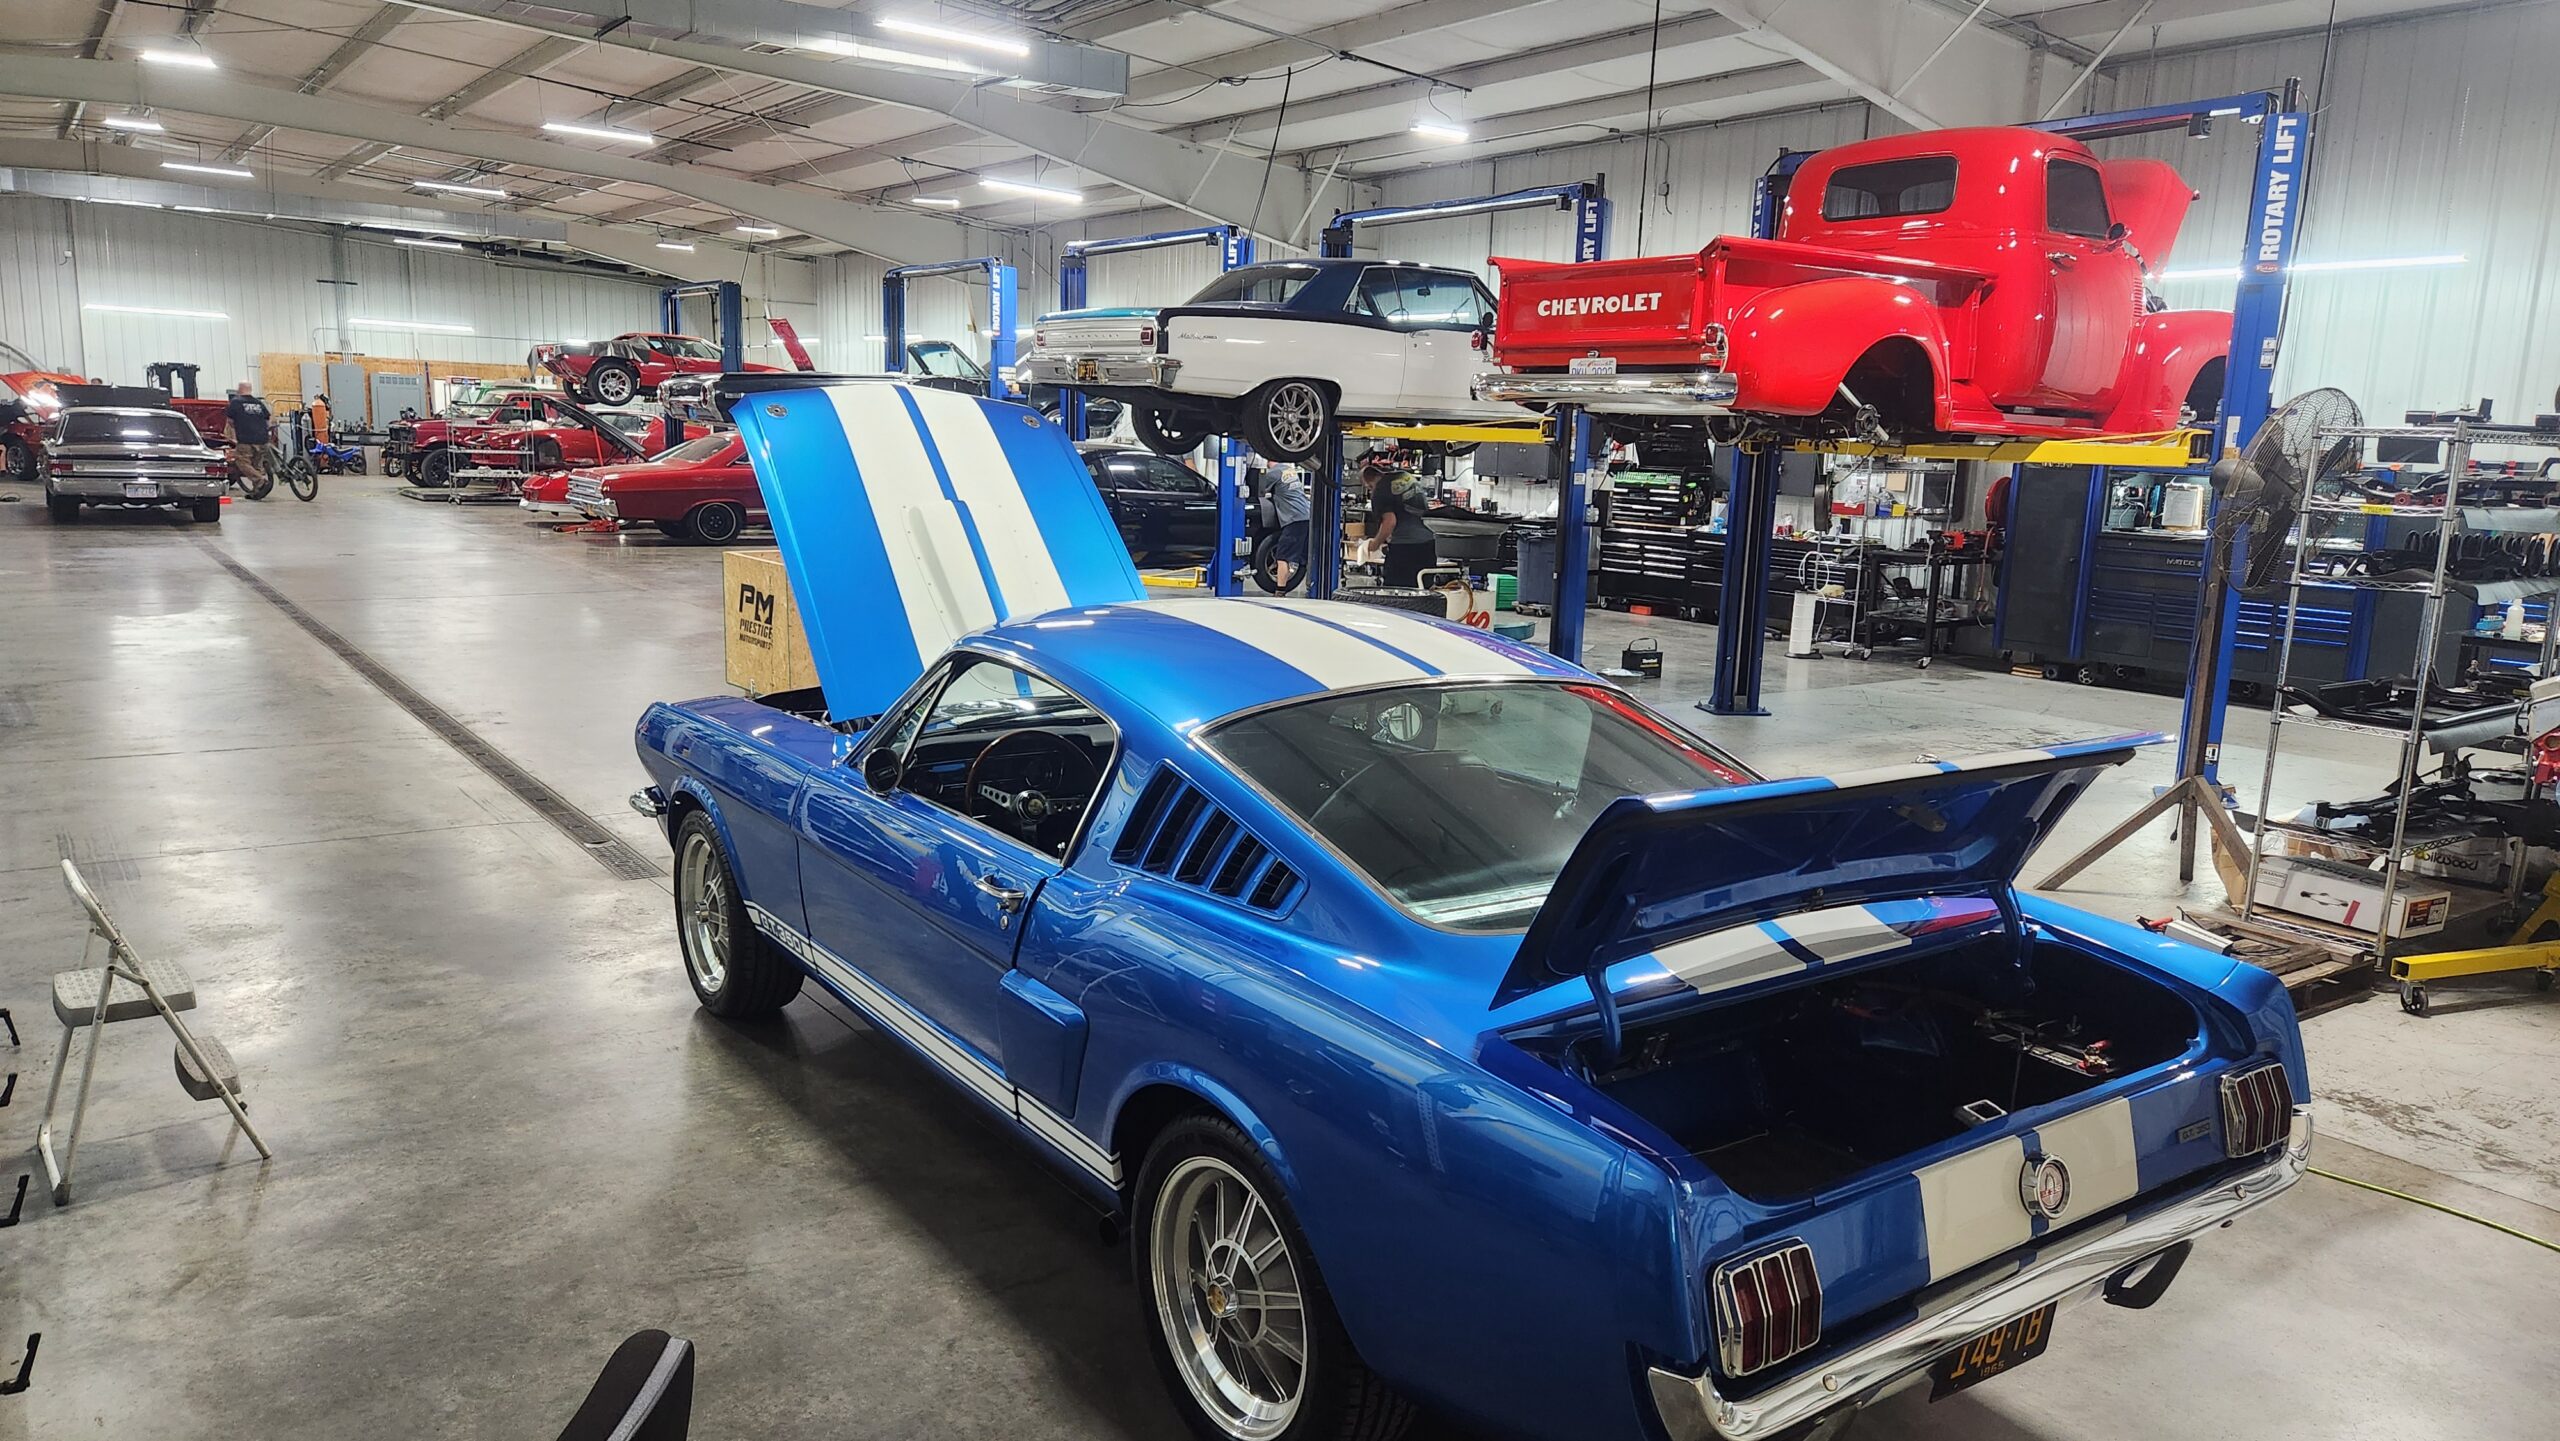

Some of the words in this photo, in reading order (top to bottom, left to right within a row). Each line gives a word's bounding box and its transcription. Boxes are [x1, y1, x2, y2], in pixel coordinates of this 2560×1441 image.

[2272, 115, 2298, 164] LIFT
[1584, 200, 1598, 233] LIFT
[2259, 170, 2290, 261] ROTARY
[1228, 237, 1238, 265] LIFT
[992, 266, 1001, 289] LIFT
[1537, 292, 1662, 317] CHEVROLET
[738, 583, 775, 626] PM
[739, 618, 774, 640] PRESTIGE
